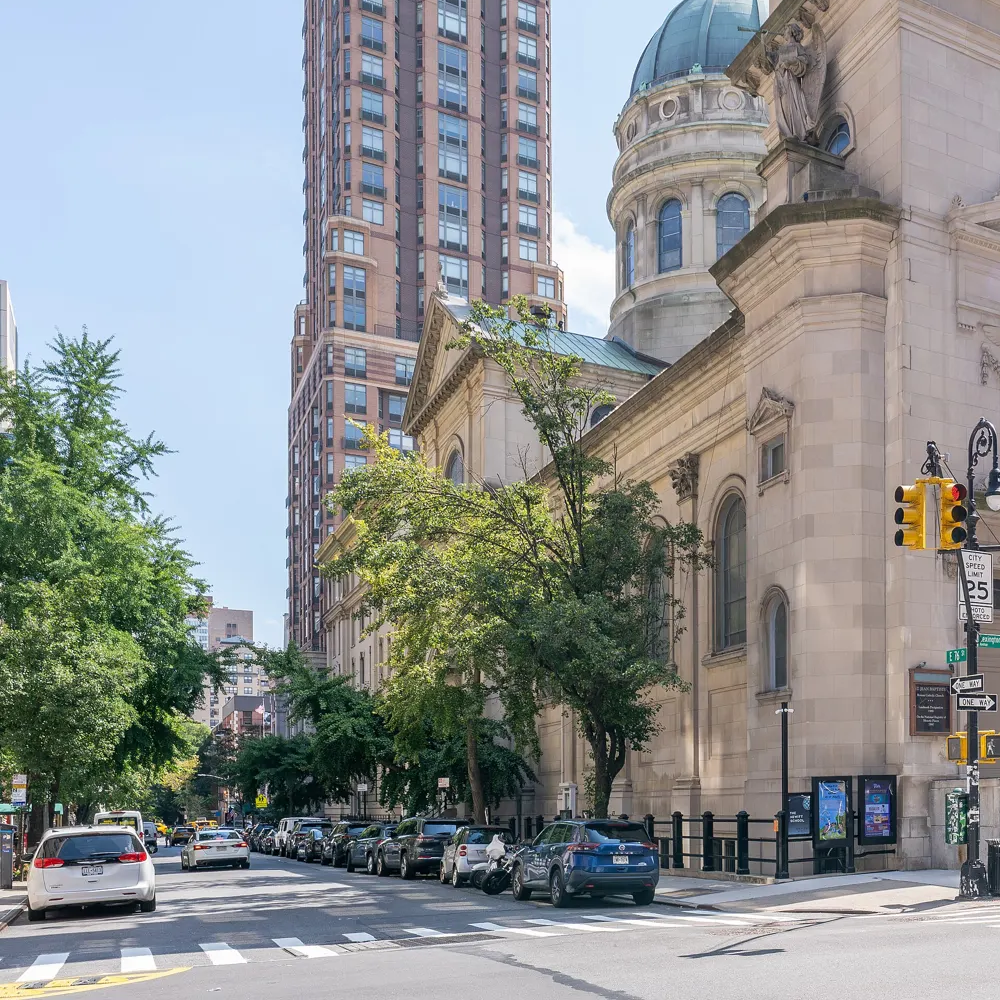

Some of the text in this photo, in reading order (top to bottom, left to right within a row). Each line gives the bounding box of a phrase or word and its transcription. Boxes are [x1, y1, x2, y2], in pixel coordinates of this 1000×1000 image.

[965, 562, 986, 570] SPEED
[966, 580, 988, 600] 25
[962, 612, 990, 620] EORCED
[954, 650, 960, 660] 76
[955, 680, 980, 690] ONE WAY
